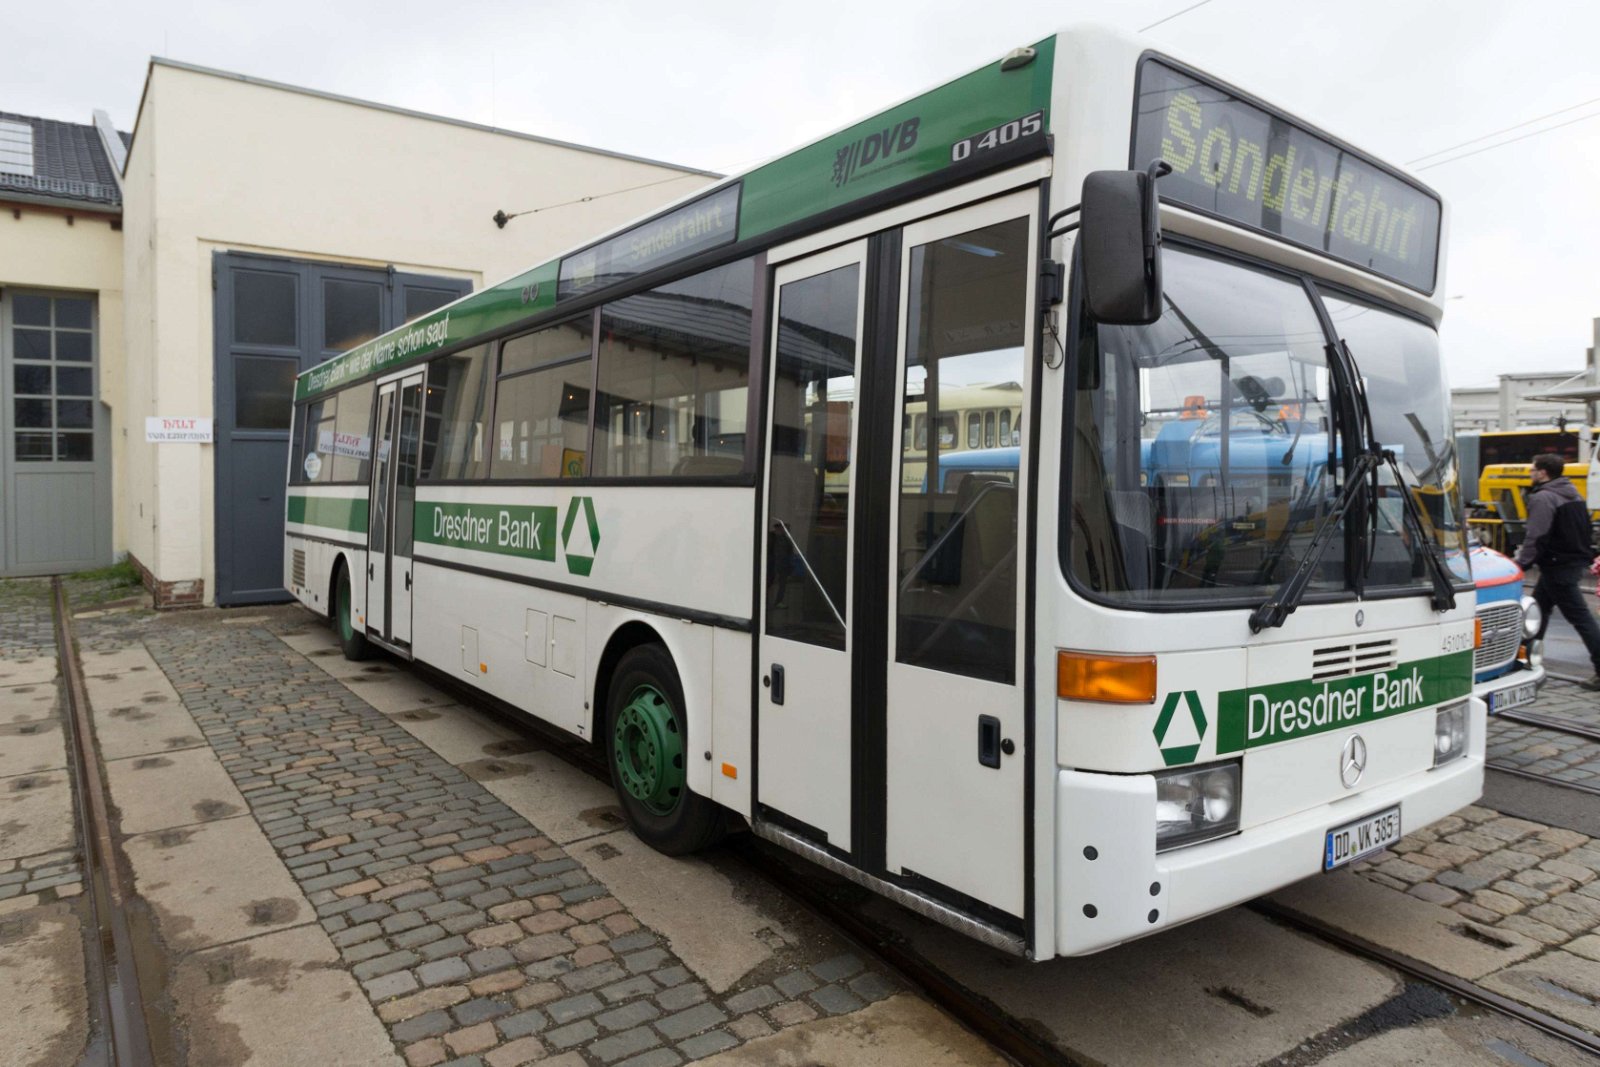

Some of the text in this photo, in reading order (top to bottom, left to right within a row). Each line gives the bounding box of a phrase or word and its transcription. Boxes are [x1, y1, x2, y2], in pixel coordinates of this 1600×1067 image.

[860, 116, 920, 168] DVB
[976, 112, 1042, 150] 405
[1161, 92, 1416, 260] Sonderfahrt
[630, 203, 722, 261] Sonderfahrt
[374, 343, 395, 363] Name
[397, 328, 424, 356] schon
[427, 312, 449, 347] sagt
[433, 507, 541, 550] Dresdner Bank
[1247, 667, 1424, 740] Dresdner Bank
[1335, 831, 1349, 860] DD
[1358, 822, 1372, 850] VK
[1374, 814, 1393, 844] 385
